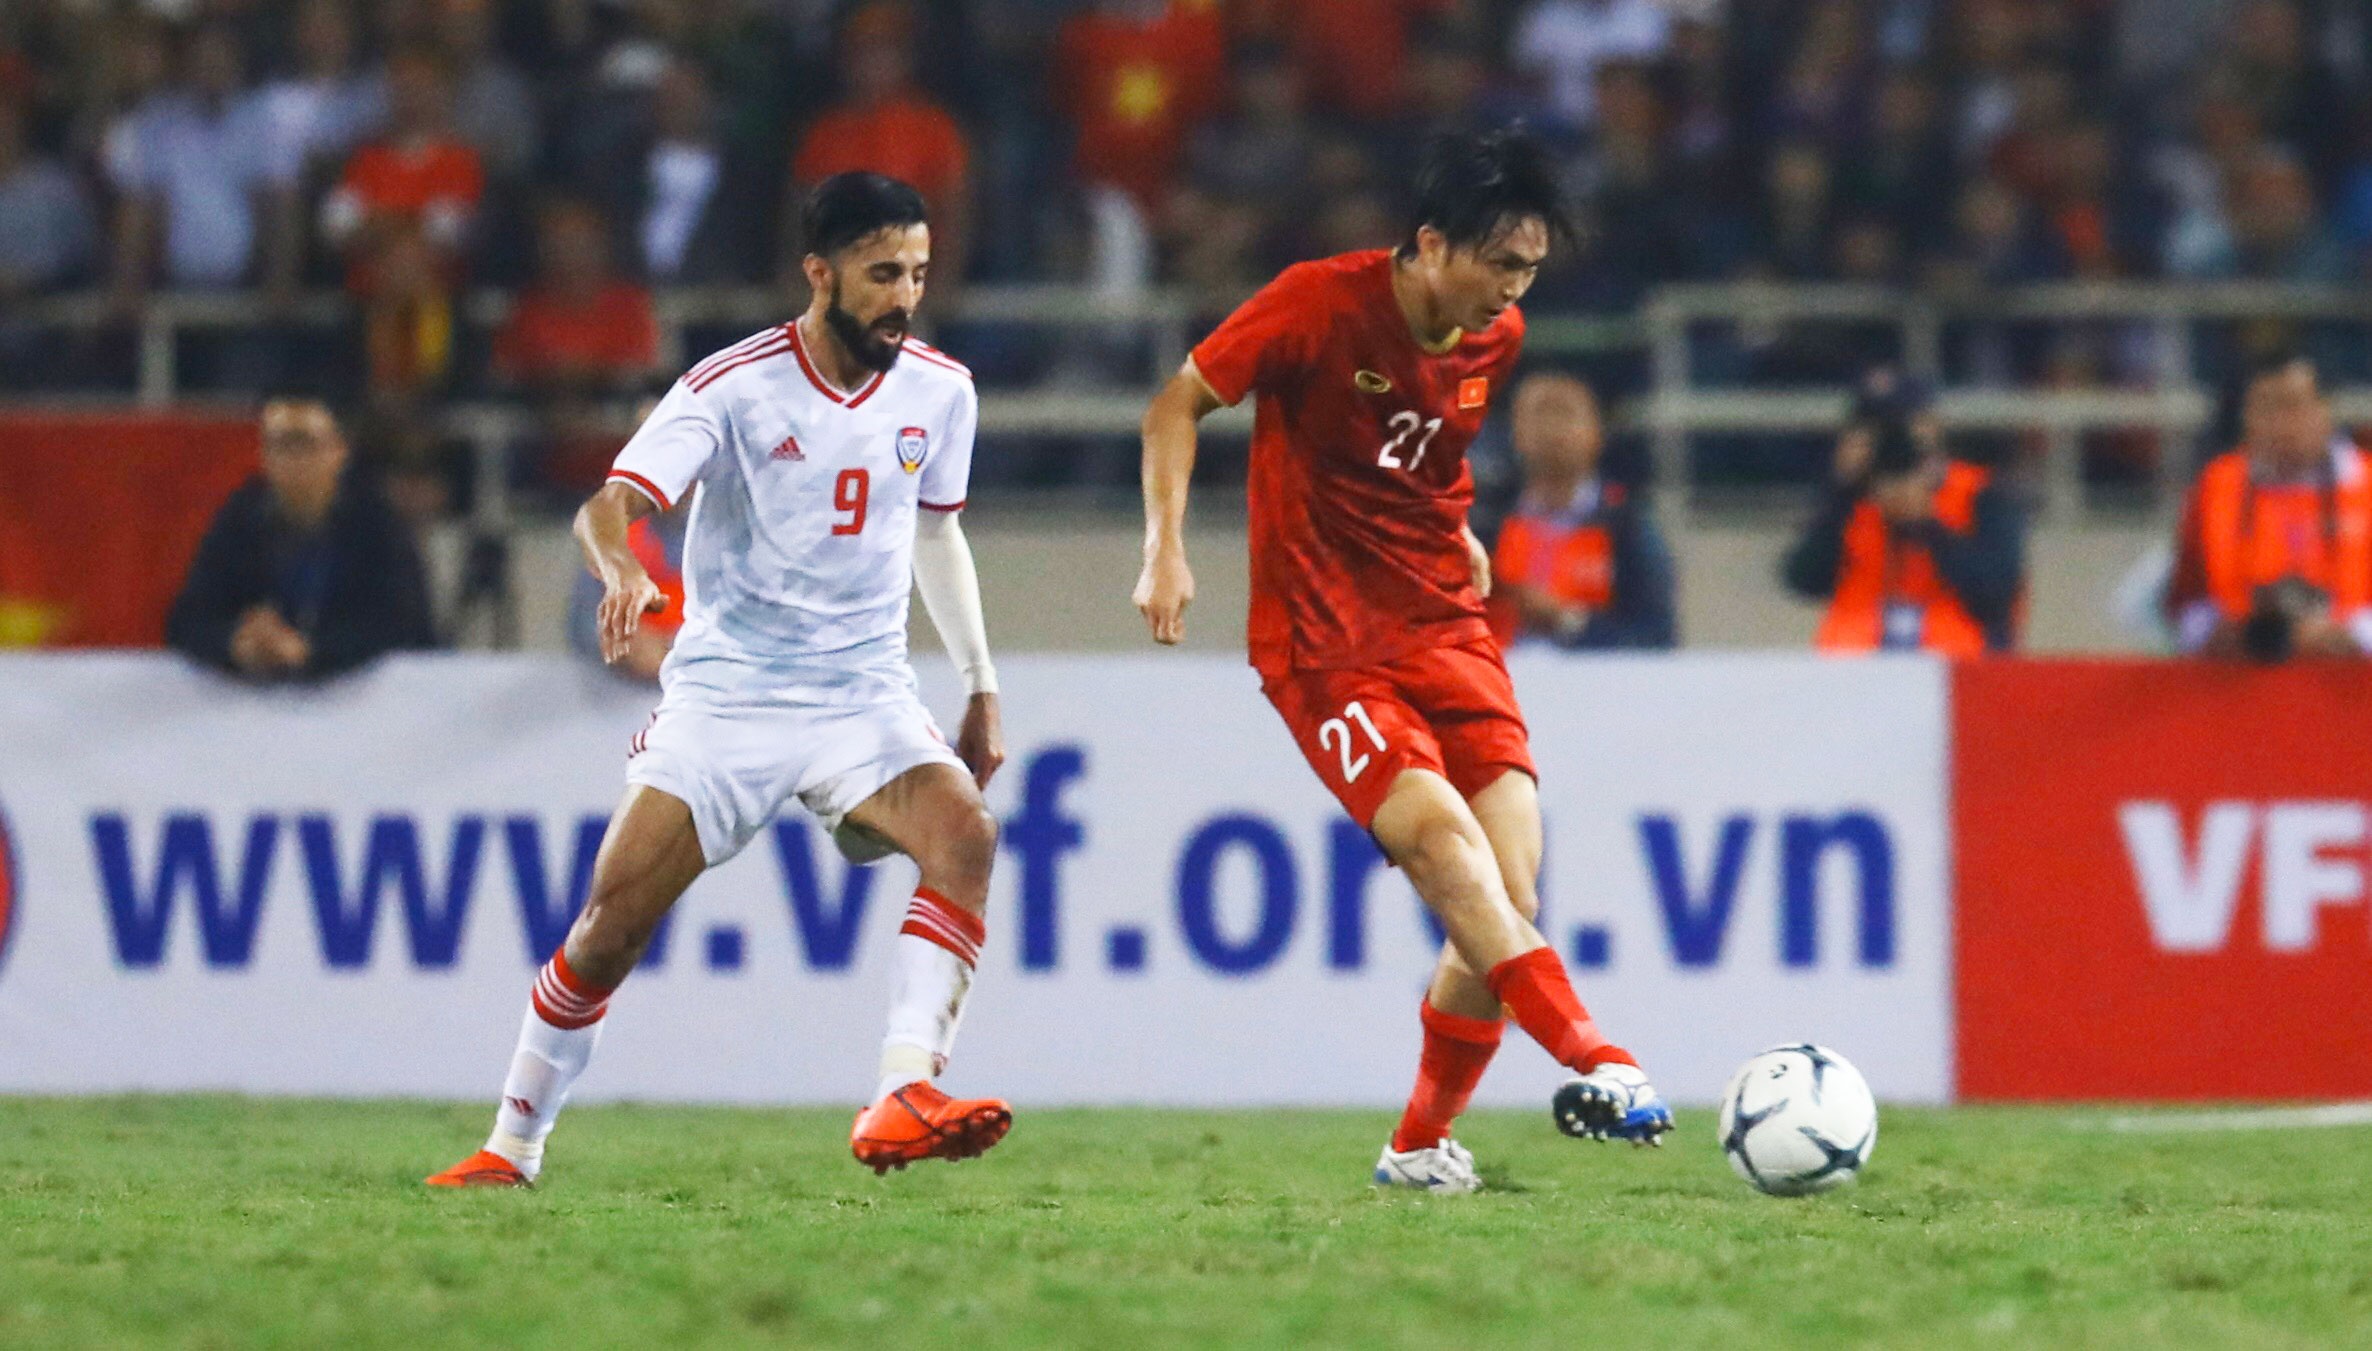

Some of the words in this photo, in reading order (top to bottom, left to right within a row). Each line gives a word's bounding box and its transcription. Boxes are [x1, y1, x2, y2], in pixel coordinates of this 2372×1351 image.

[1377, 410, 1443, 472] 21
[831, 467, 870, 537] 9
[1318, 700, 1387, 784] 21
[87, 745, 1897, 1030] ww.vf.or.vn
